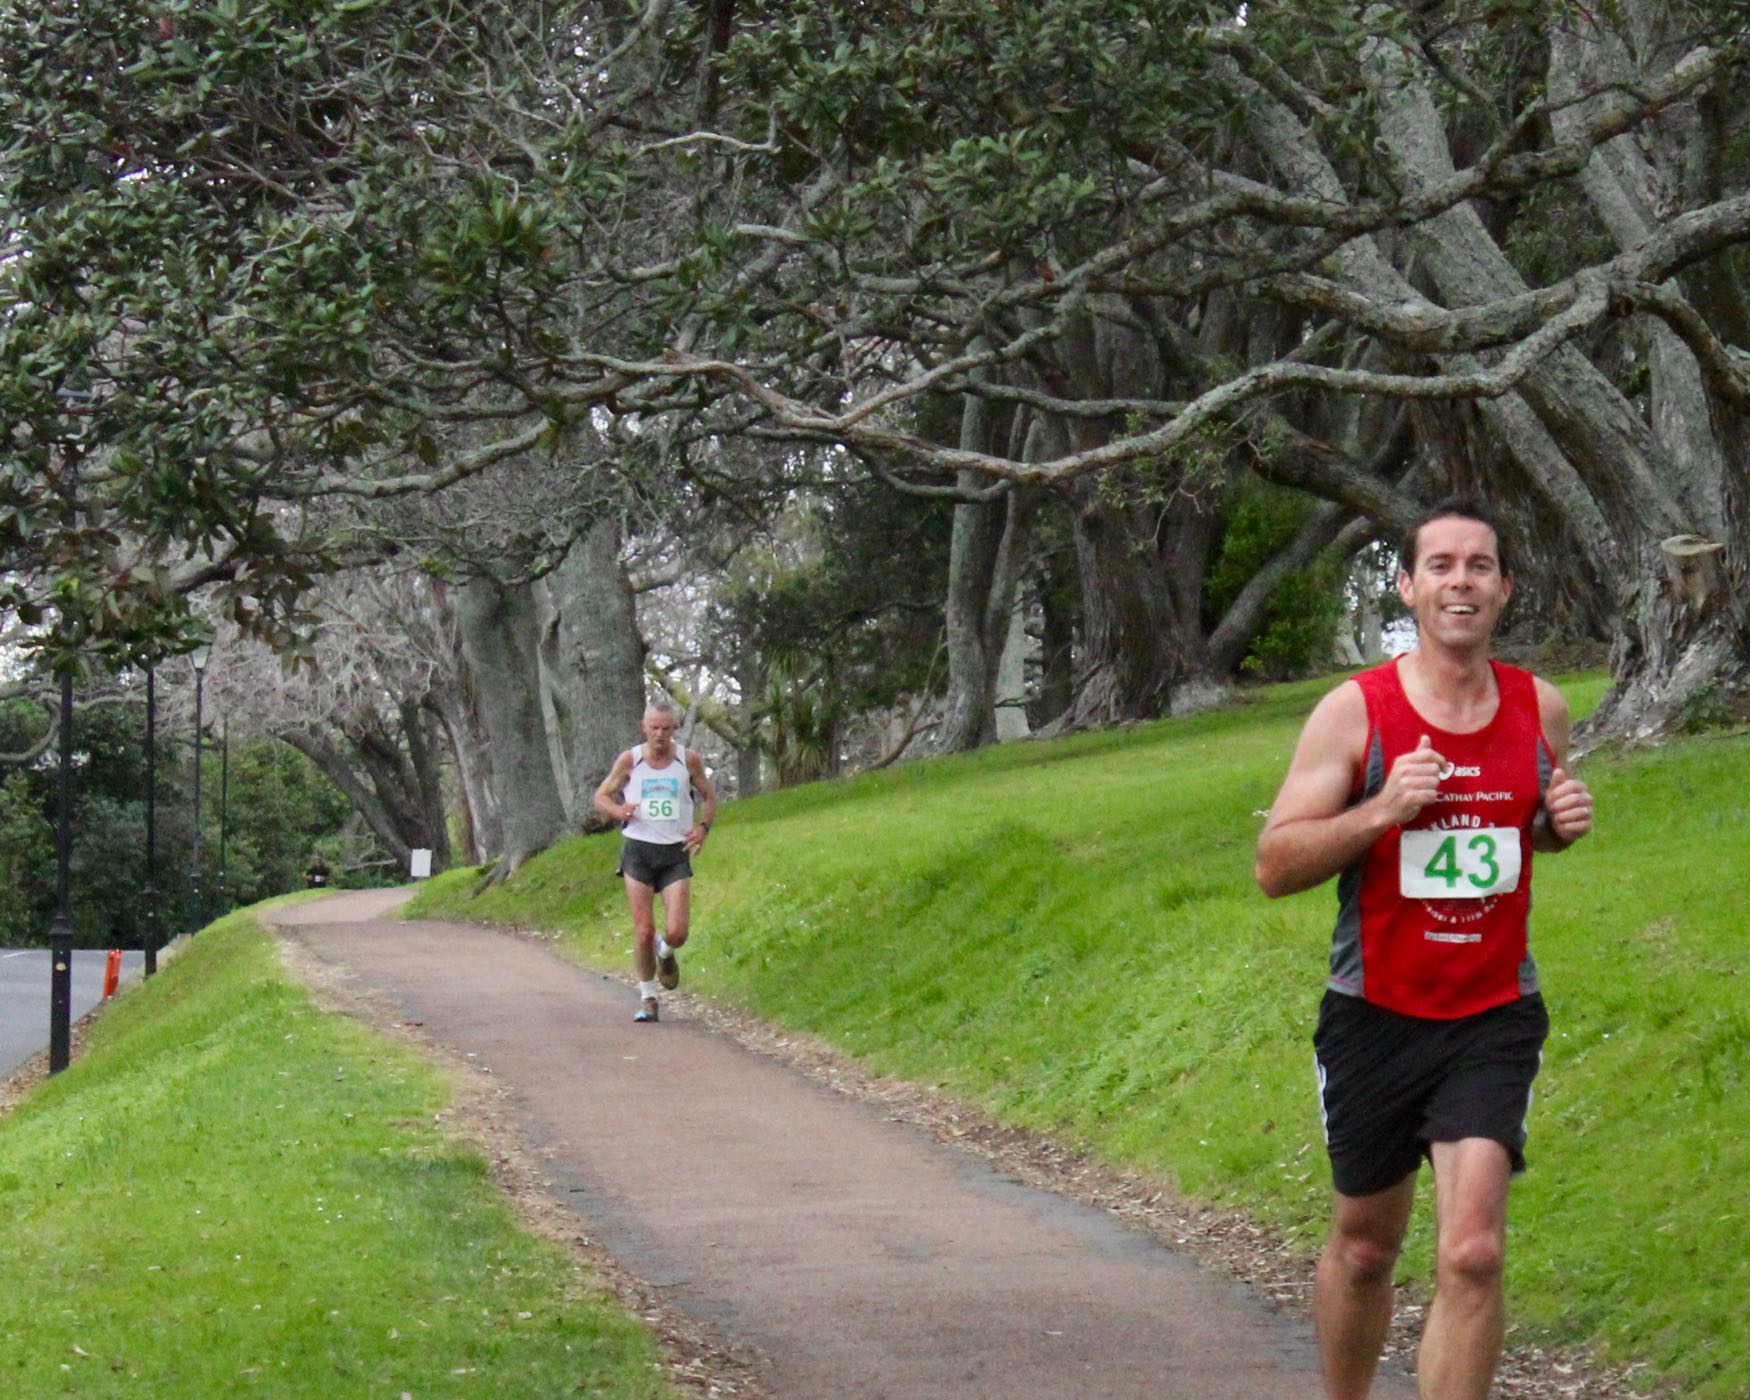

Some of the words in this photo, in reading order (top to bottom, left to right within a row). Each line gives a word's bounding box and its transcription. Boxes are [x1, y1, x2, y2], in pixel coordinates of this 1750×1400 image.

[1454, 766, 1481, 777] asics
[1475, 790, 1514, 802] PACIFIC
[649, 800, 673, 817] 56
[1424, 834, 1500, 888] 43
